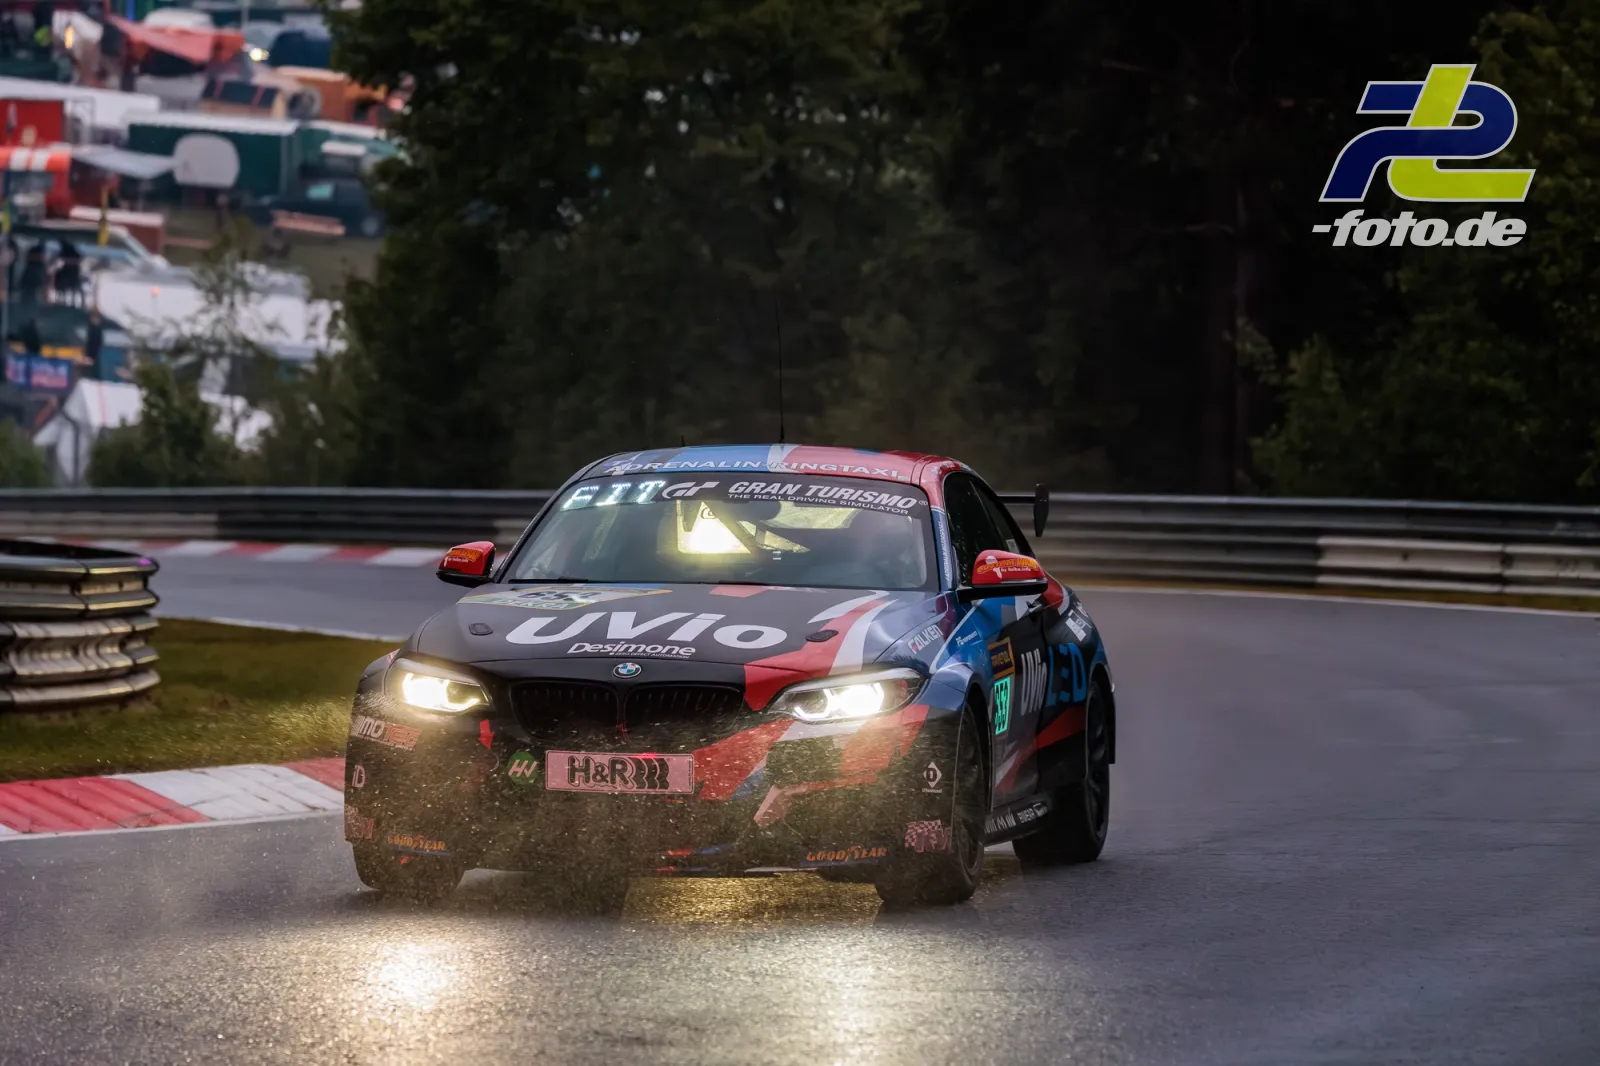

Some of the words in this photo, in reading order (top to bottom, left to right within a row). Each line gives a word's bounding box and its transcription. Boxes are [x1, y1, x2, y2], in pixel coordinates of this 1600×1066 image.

[769, 462, 898, 479] RINGTAXI
[728, 481, 802, 496] GRAN
[808, 485, 918, 510] TURISMO
[787, 496, 837, 505] DRIVING
[839, 501, 909, 516] SIMULATOR
[567, 641, 697, 656] Desimone
[568, 756, 635, 789] H&R
[806, 845, 888, 862] GOODYEAR
